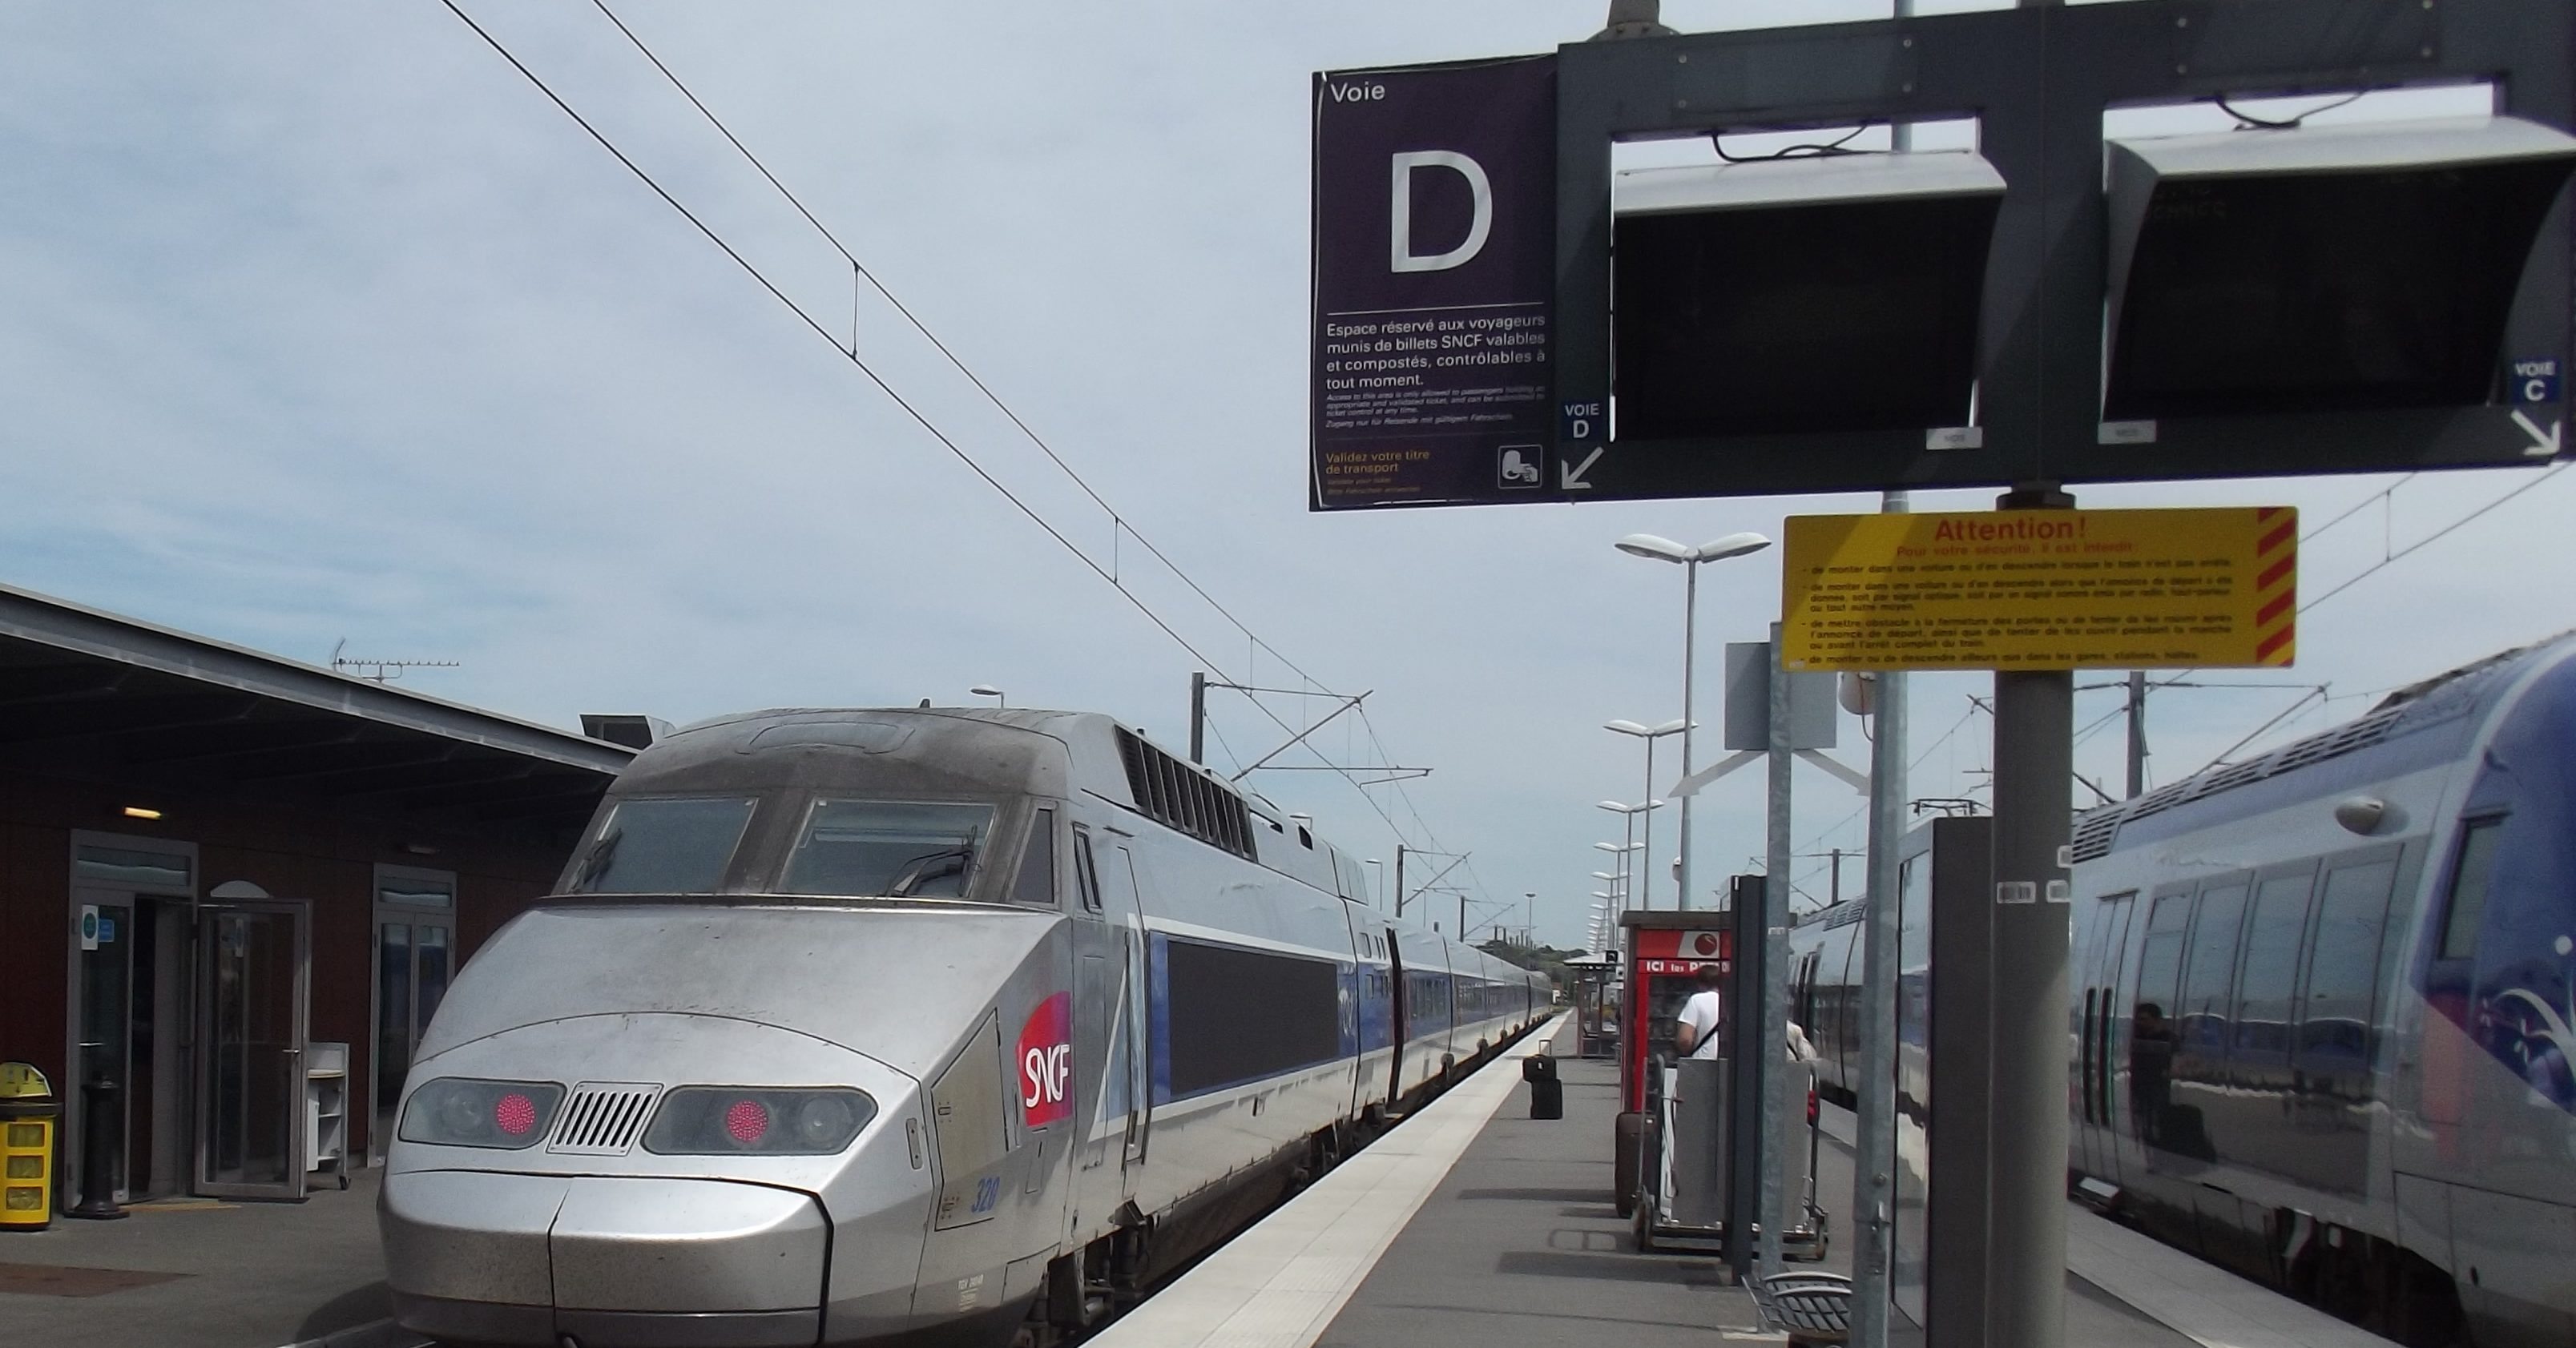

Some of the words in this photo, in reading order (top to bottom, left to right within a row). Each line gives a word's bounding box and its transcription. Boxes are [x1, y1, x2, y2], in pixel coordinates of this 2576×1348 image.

[1329, 82, 1385, 103] Voie
[1391, 149, 1494, 273] D
[1327, 321, 1377, 337] Espace
[1381, 320, 1433, 336] réservé
[1439, 318, 1464, 334] aux
[1469, 316, 1545, 333] voyageurs
[1327, 340, 1370, 354] munis
[1374, 339, 1391, 352] de
[1396, 337, 1437, 352] billets
[1441, 335, 1482, 349] SNCF
[1486, 333, 1545, 348] valables
[1327, 360, 1340, 373] et
[1344, 355, 1431, 372] compostés,
[1437, 350, 1531, 368] contrôlables
[1537, 350, 1545, 363] à
[2514, 361, 2554, 377] VOIE
[1327, 376, 1354, 389] tout
[1359, 374, 1424, 388] moment.
[2524, 380, 2545, 401] C
[1565, 403, 1599, 416] VOIE
[1573, 420, 1590, 439] D
[1326, 452, 1366, 463] Validez
[1372, 451, 1401, 462] votre
[1405, 450, 1429, 461] titre
[1326, 464, 1340, 474] de
[1344, 463, 1398, 474] transport
[1897, 547, 1926, 556] Pour
[1934, 545, 1968, 556] votre
[1646, 961, 1665, 972] ICI
[1025, 1043, 1070, 1109] SNCF
[970, 1175, 1000, 1214] 320
